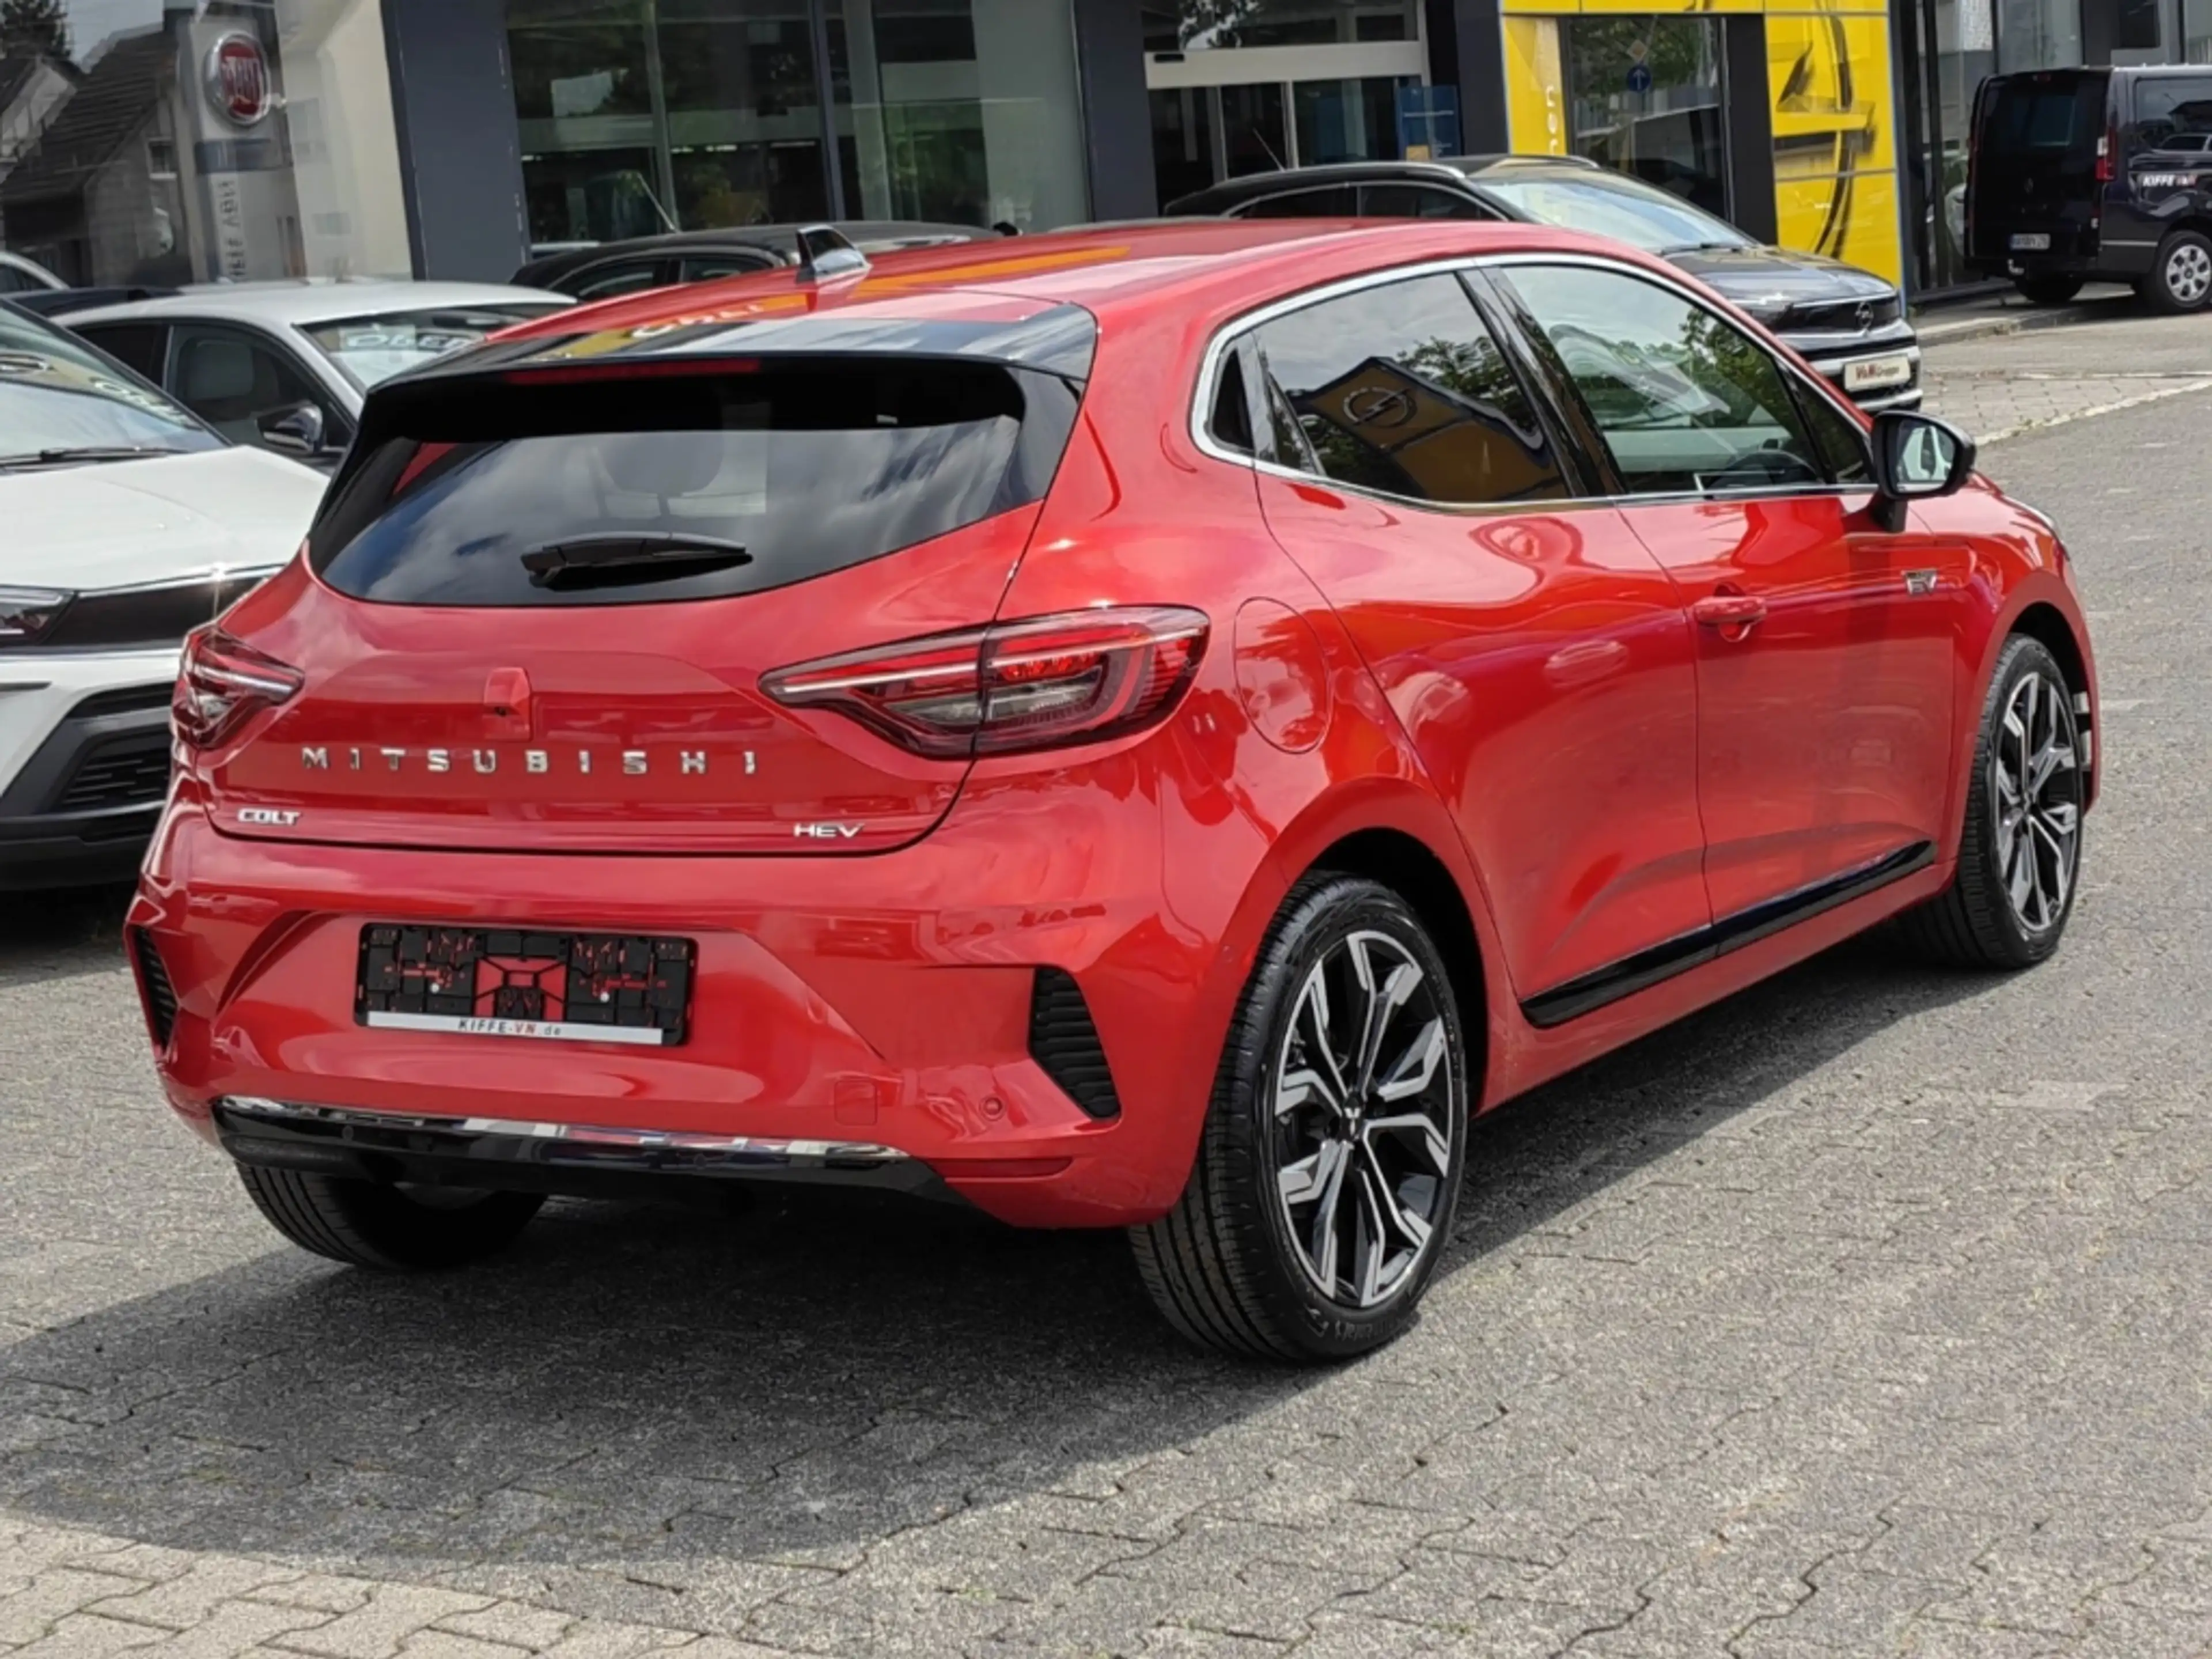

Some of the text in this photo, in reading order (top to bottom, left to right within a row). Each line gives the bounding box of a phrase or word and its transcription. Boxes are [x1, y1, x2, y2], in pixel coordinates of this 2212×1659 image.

[301, 747, 756, 775] MITSUBISHI
[237, 808, 301, 825] COLT
[793, 821, 865, 839] HEV
